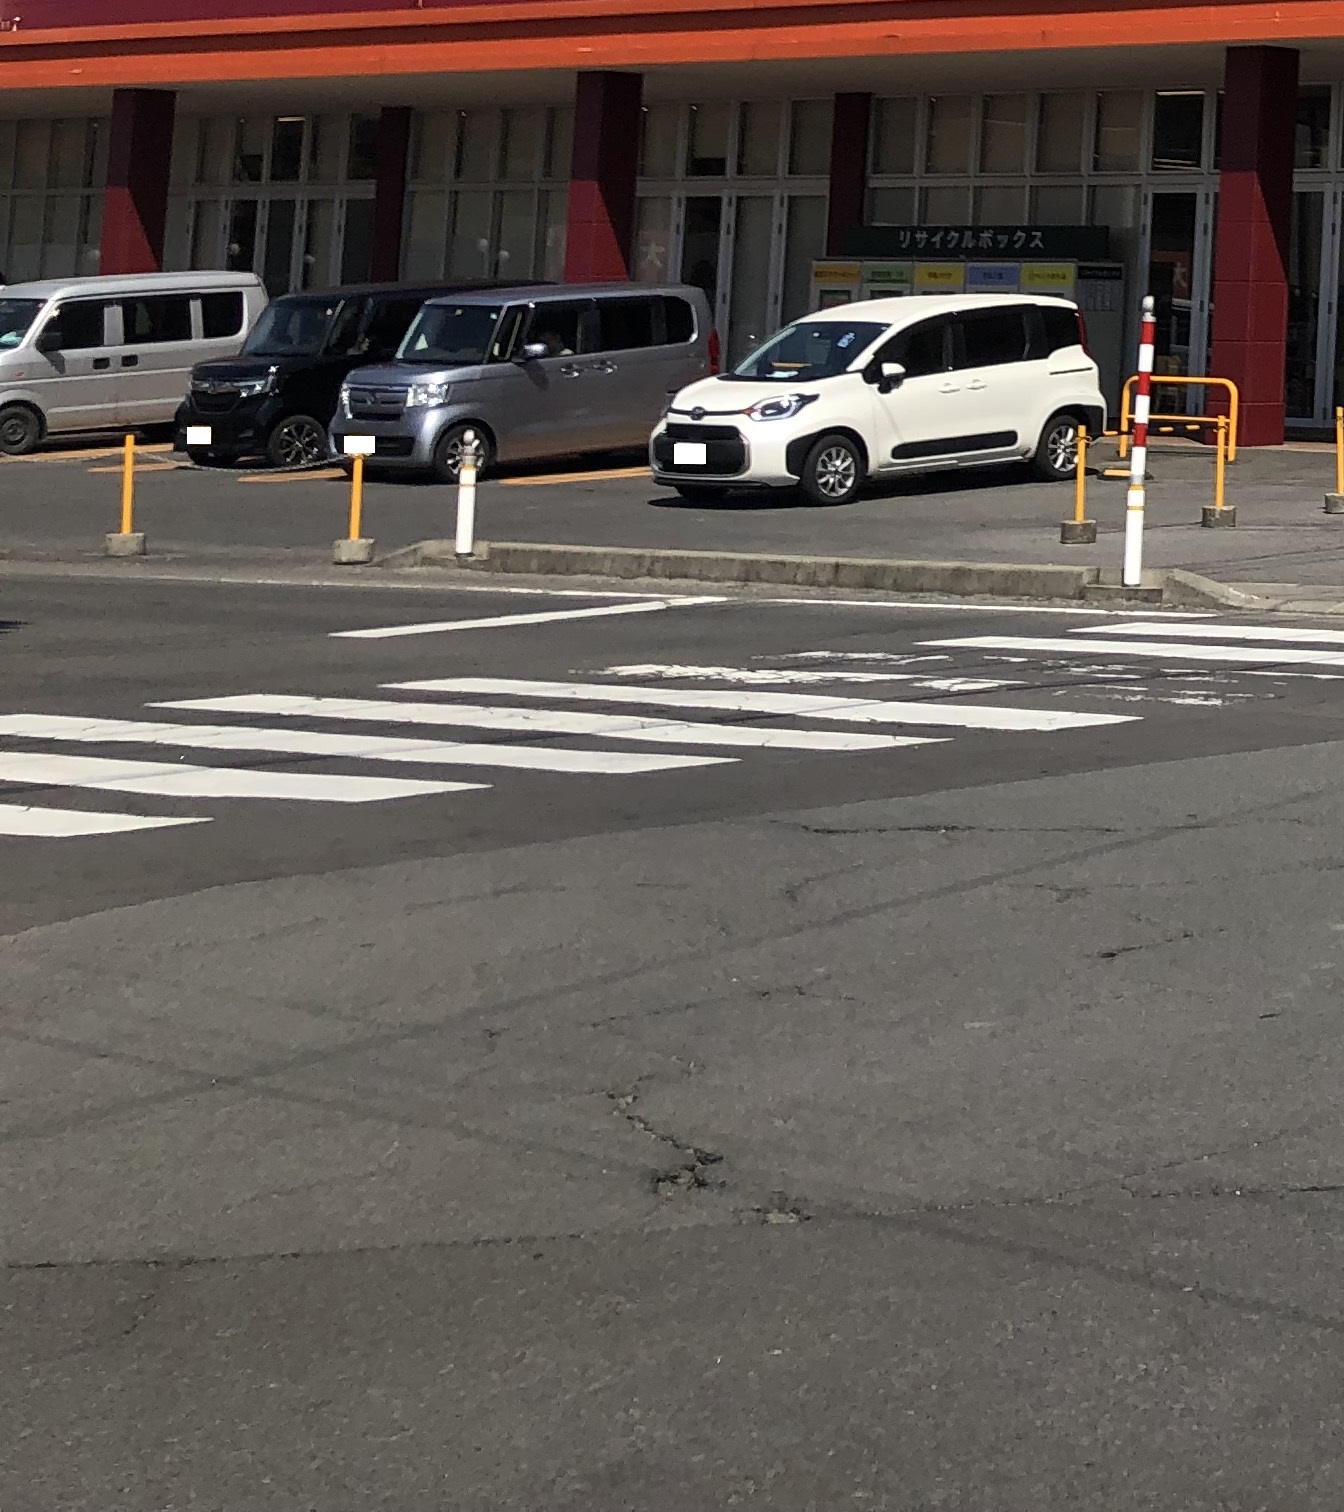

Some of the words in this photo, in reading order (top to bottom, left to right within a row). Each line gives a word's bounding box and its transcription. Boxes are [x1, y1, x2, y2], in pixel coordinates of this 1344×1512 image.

[899, 230, 1045, 250] リサイクルボックス
